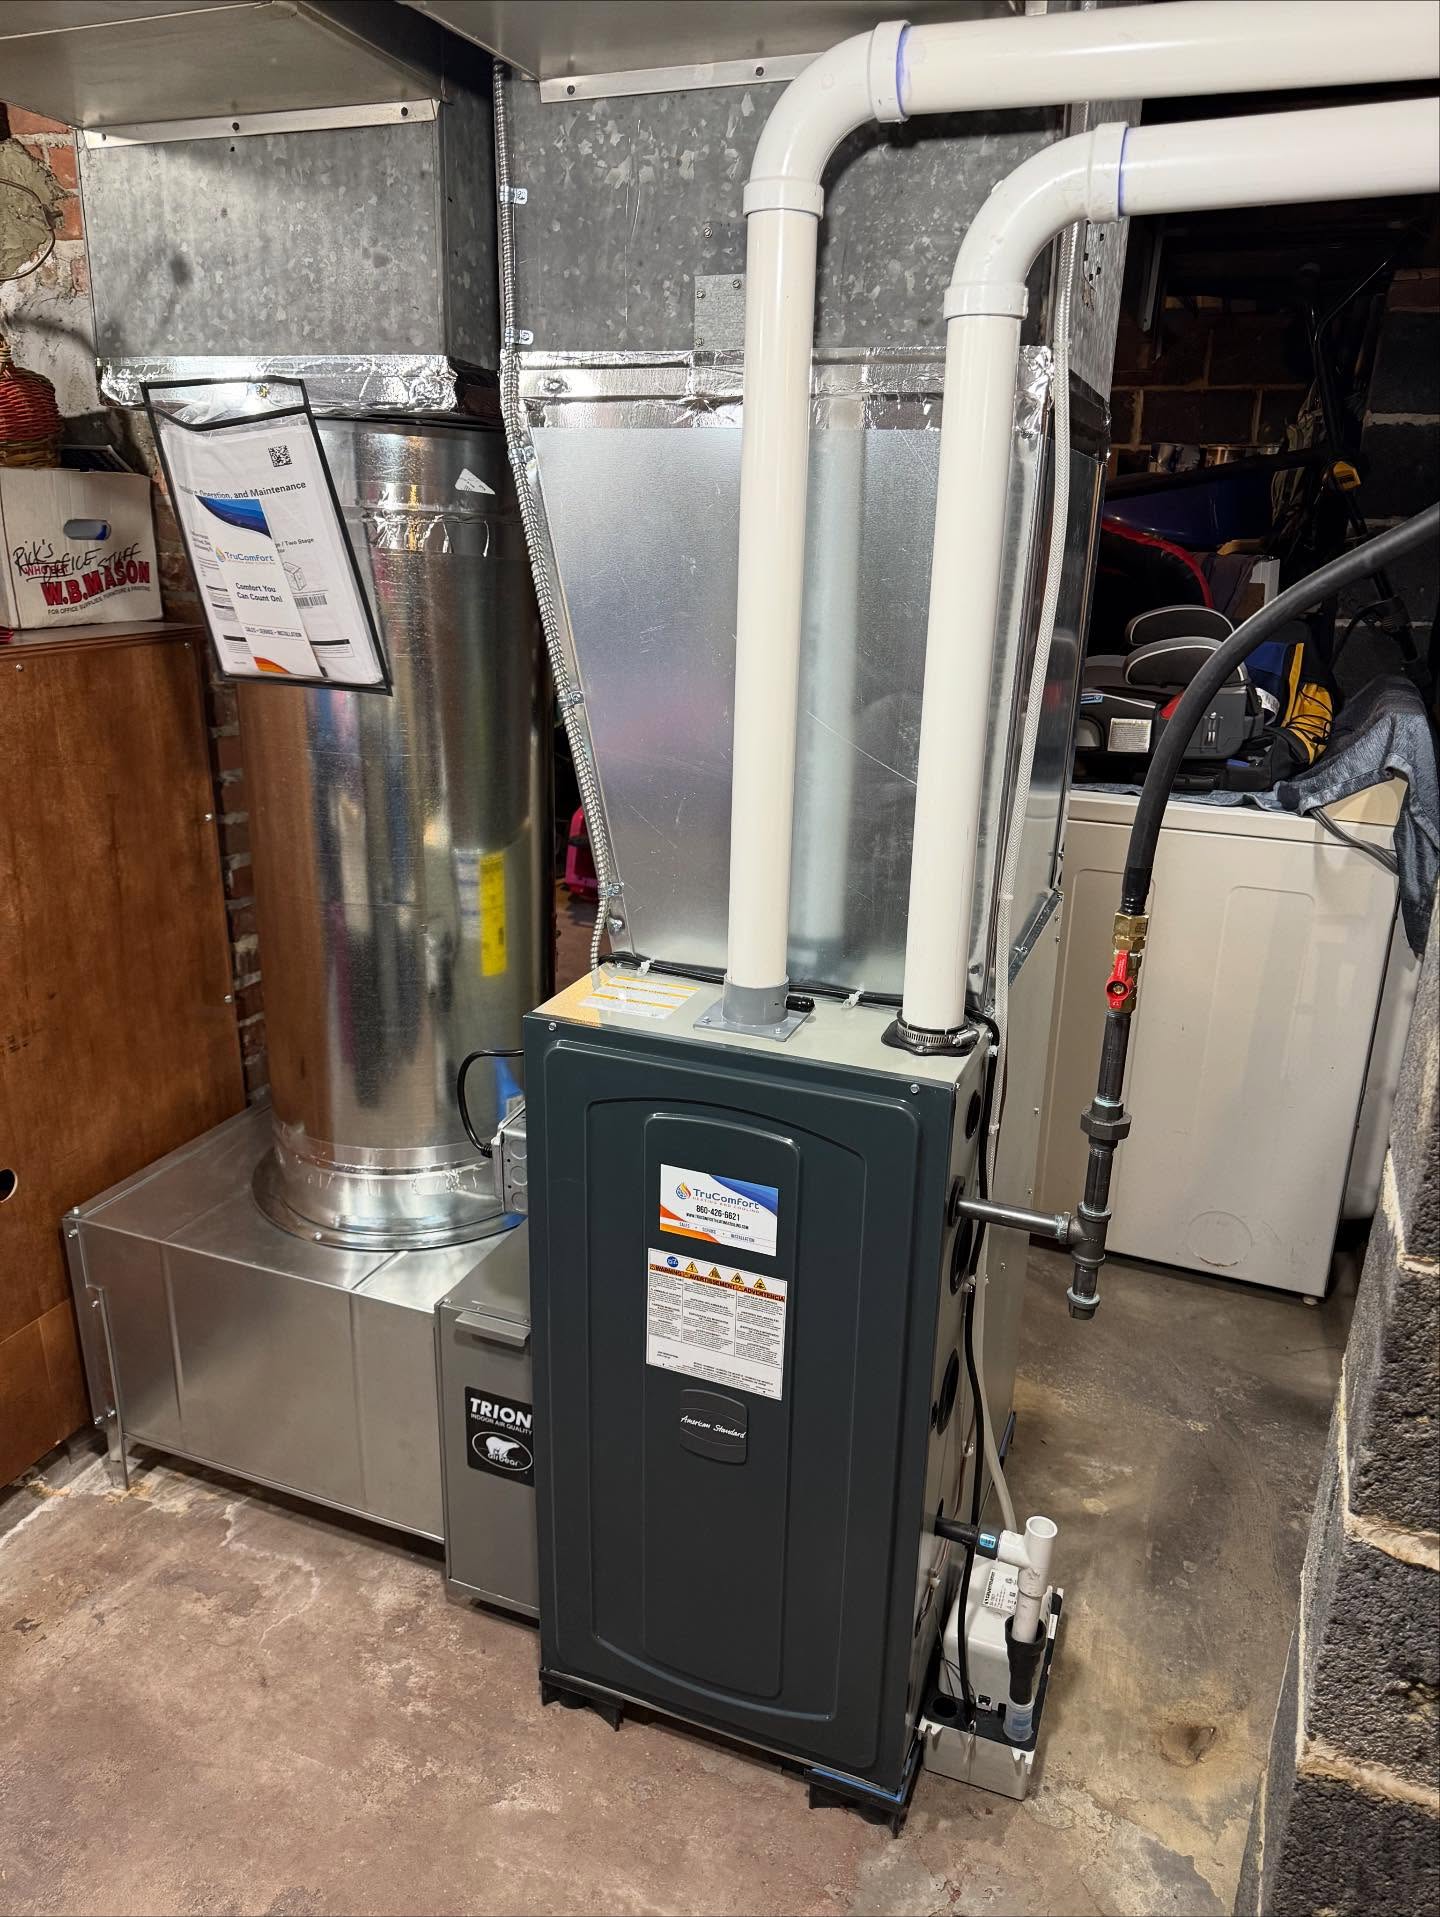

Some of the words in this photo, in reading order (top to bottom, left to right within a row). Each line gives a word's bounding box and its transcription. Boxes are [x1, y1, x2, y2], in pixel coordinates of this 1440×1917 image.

[250, 481, 307, 498] Maintenance
[235, 582, 261, 593] Comfort
[262, 584, 276, 593] You
[236, 592, 250, 600] Can
[250, 594, 270, 602] Count
[696, 1205, 741, 1221] 860-426-6621
[470, 1397, 533, 1429] TRION
[470, 1413, 494, 1424] INDOOR
[495, 1419, 505, 1428] AIR
[506, 1423, 533, 1436] QUALITY
[680, 1414, 711, 1429] American
[713, 1424, 747, 1439] Standard
